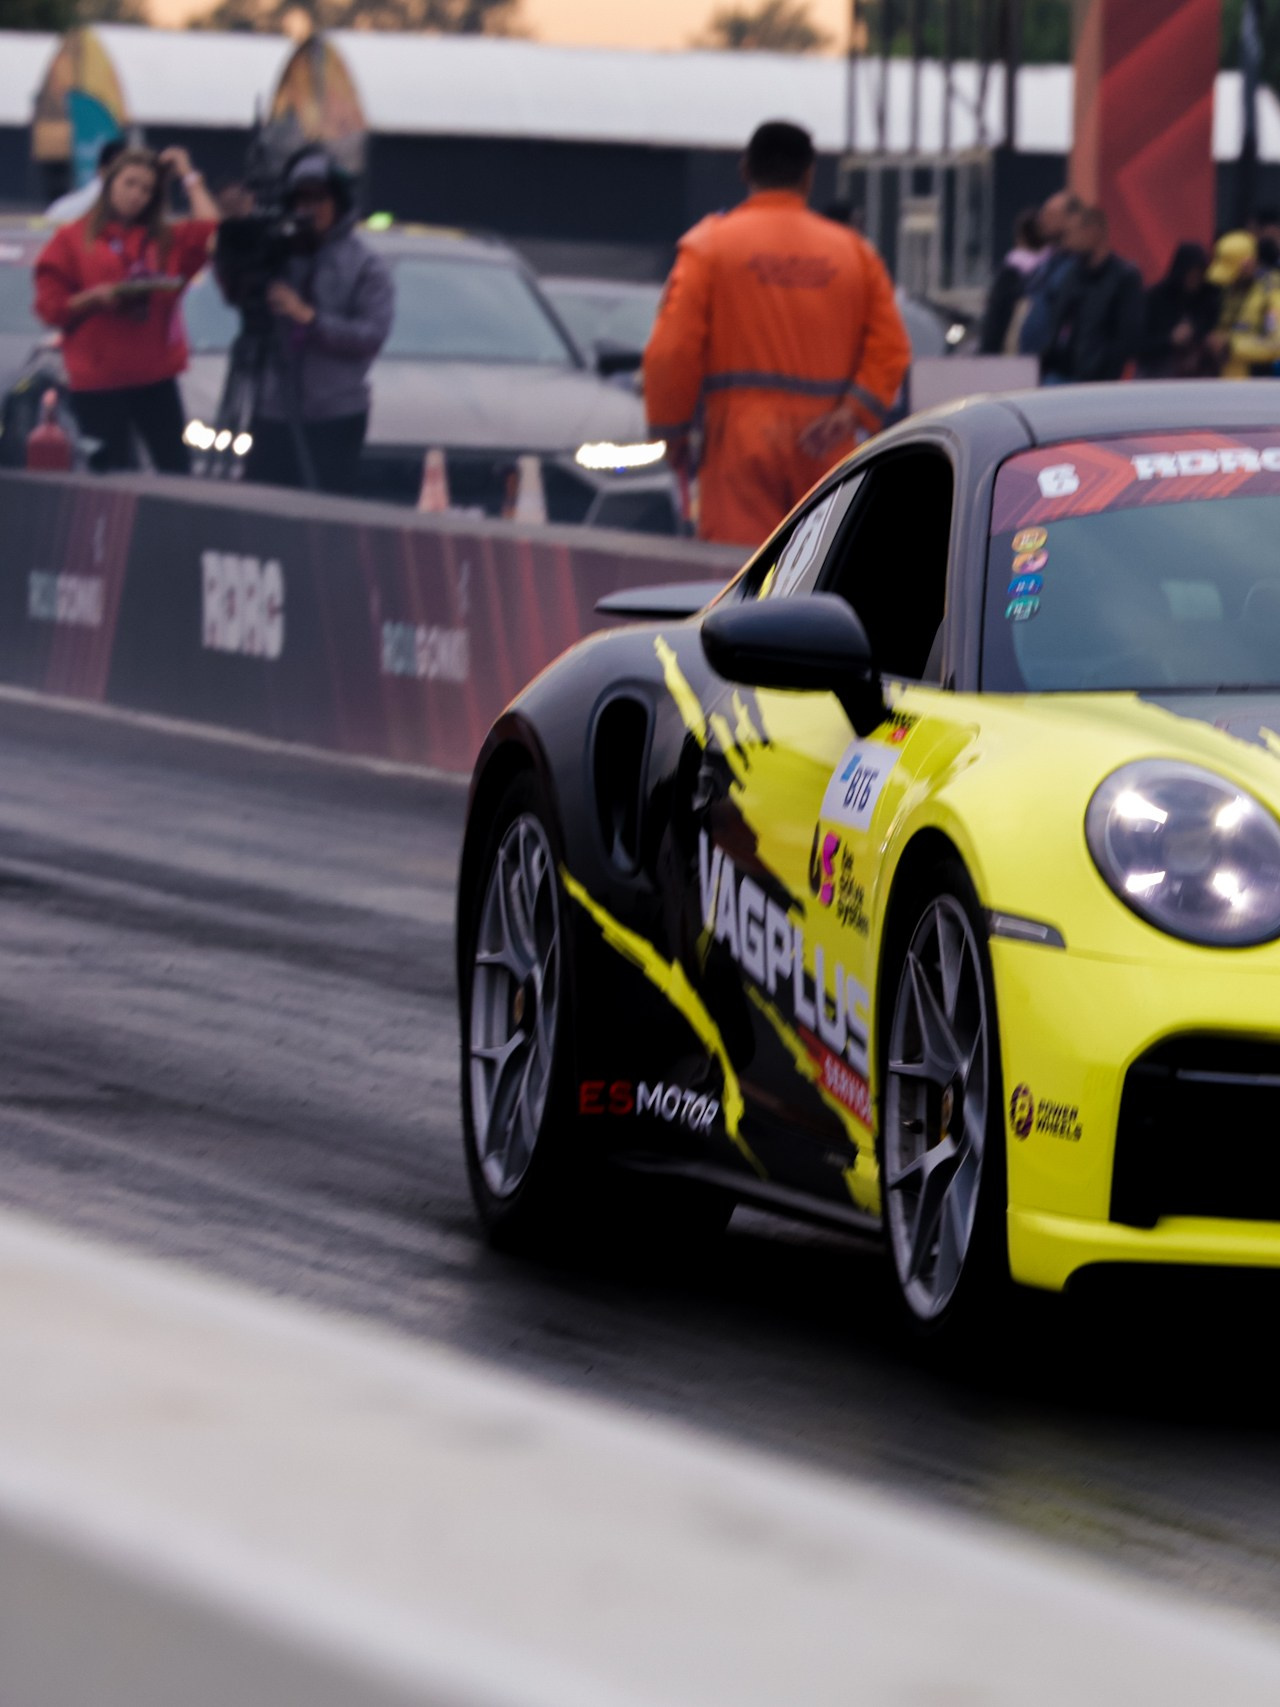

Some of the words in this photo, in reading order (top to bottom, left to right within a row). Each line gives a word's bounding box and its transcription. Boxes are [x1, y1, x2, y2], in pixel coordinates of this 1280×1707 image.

[200, 549, 285, 660] RDRC
[698, 827, 869, 1078] VAGPLUS
[1035, 1117, 1083, 1142] WHEELS
[1038, 1098, 1079, 1122] POWER
